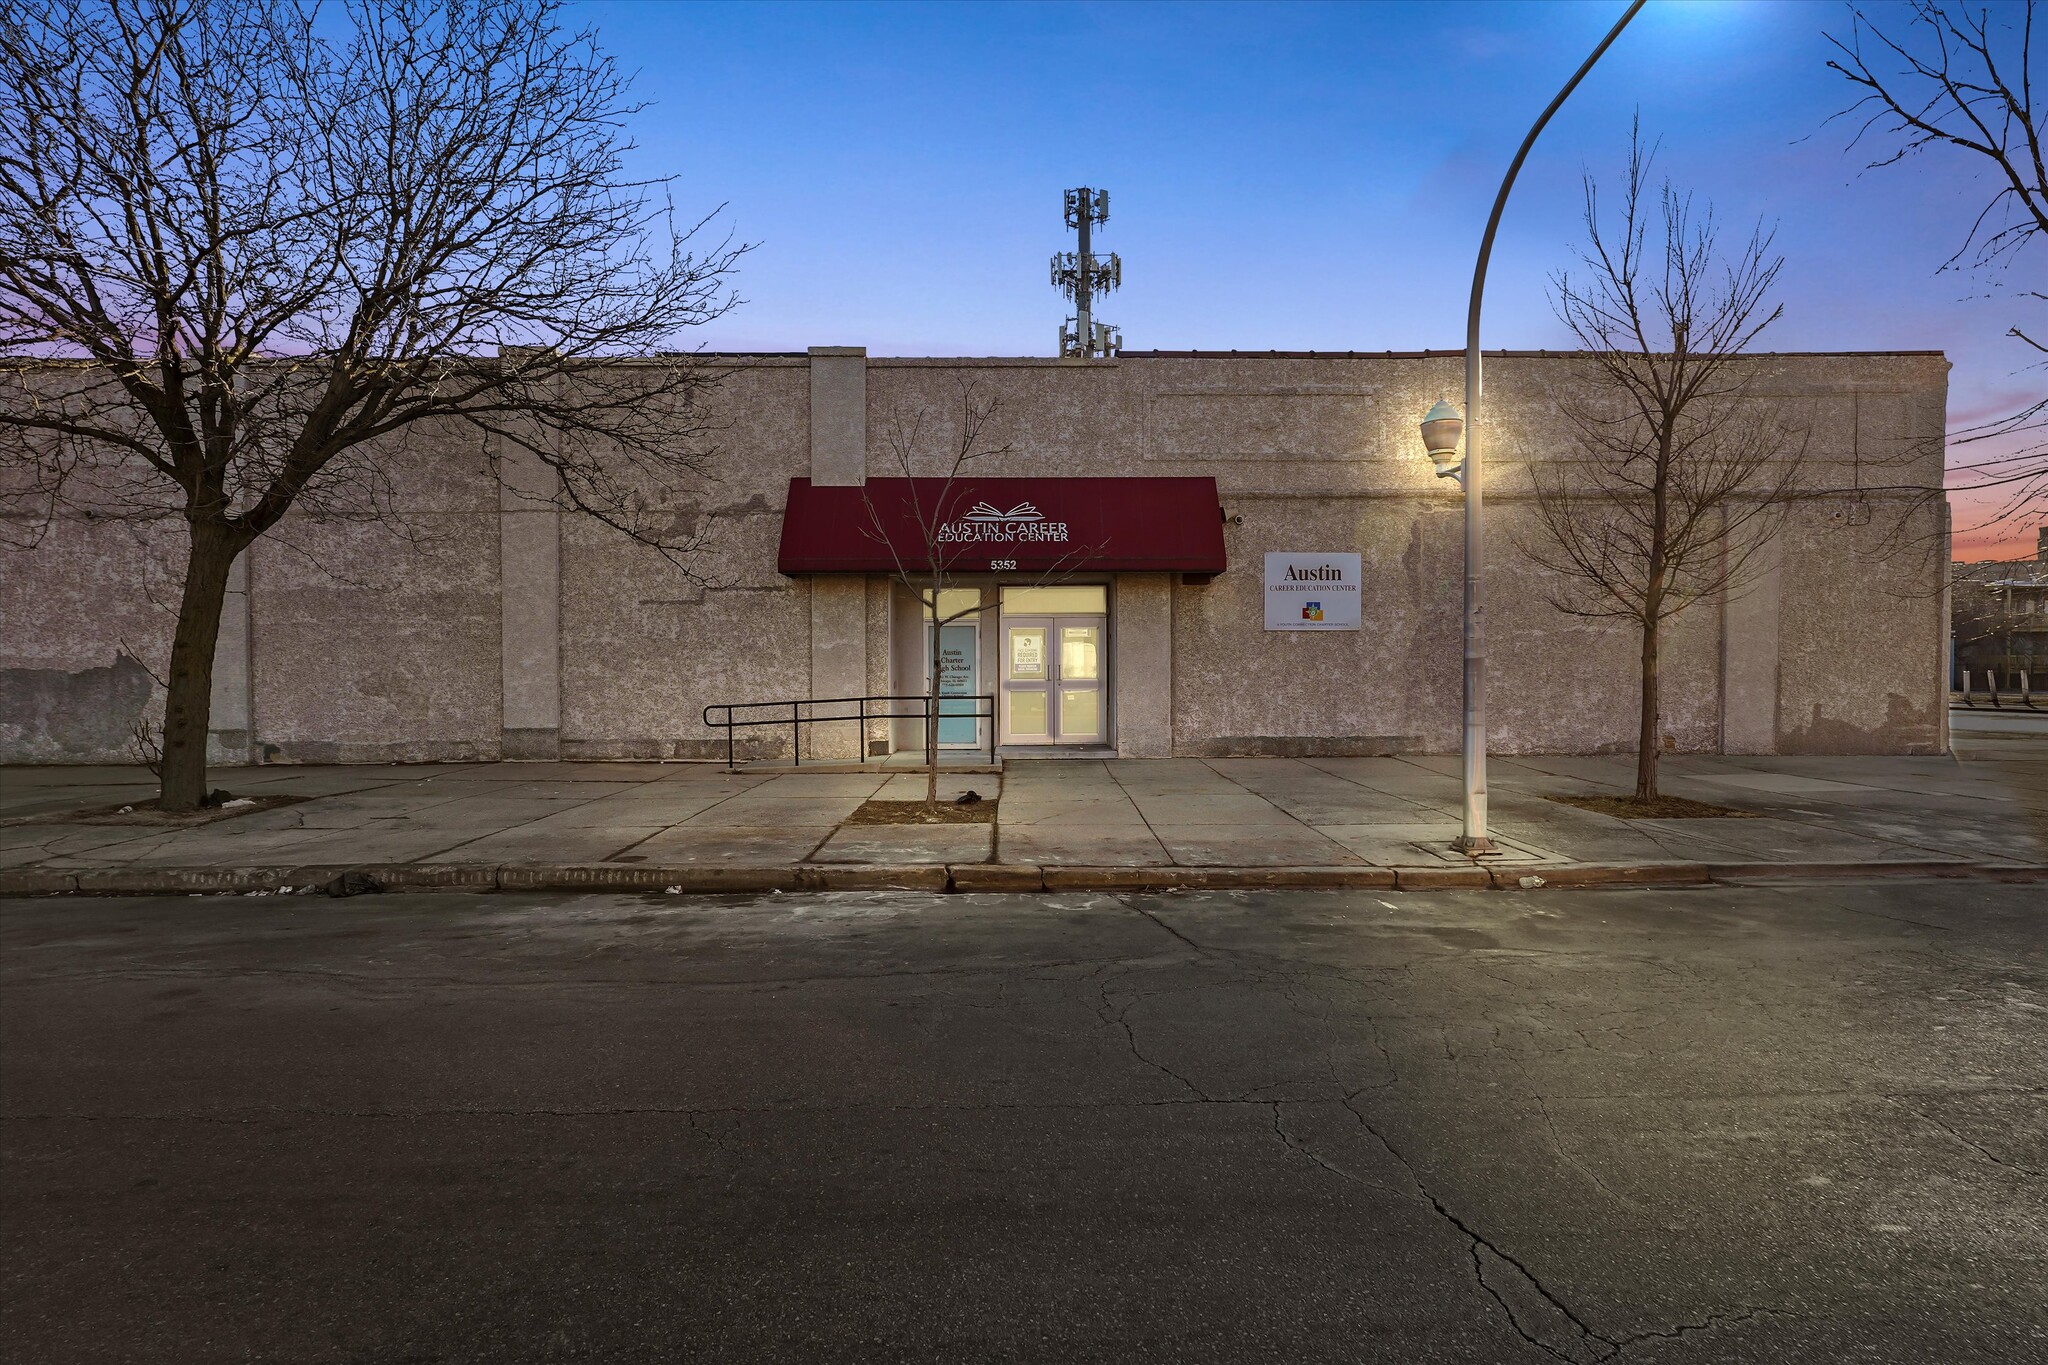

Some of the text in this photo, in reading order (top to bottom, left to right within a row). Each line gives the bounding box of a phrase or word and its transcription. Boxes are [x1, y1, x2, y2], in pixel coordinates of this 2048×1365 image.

[938, 522, 1068, 534] AUSTIN CAREER
[938, 533, 1069, 542] EDUCATION CENTER
[990, 560, 1017, 570] 5352
[1284, 564, 1342, 581] Austin
